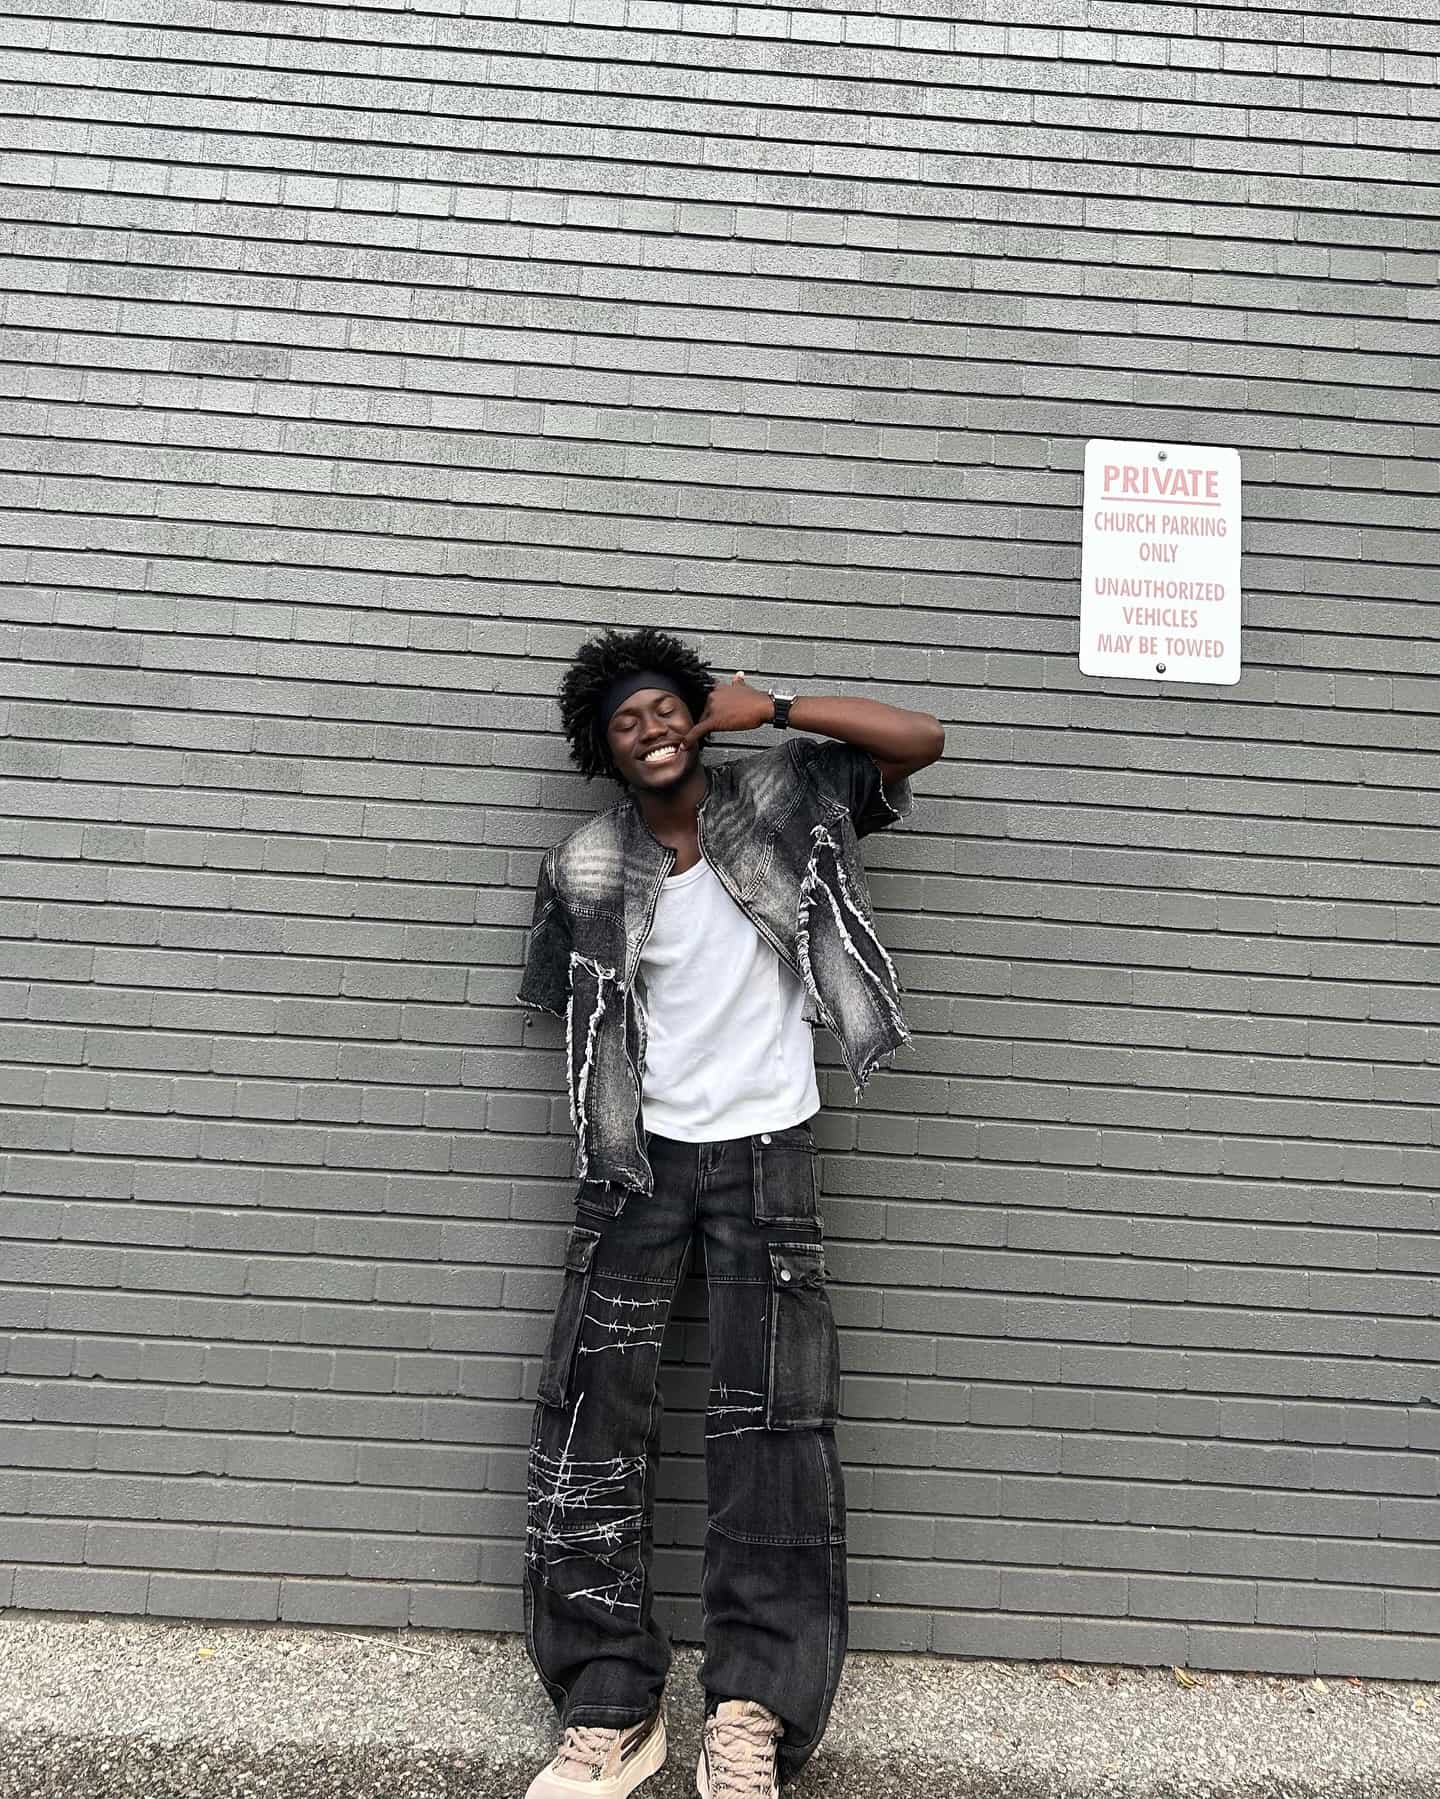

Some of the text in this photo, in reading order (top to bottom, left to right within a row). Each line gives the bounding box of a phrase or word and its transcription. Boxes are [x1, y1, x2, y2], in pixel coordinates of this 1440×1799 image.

[1103, 465, 1218, 498] PRIVATE
[1094, 511, 1227, 537] CHURCH PARKING
[1139, 542, 1178, 563] ONLY
[1095, 577, 1225, 601] UNAUTHORIZED
[1122, 606, 1198, 628] VEHICLES
[1097, 633, 1225, 658] MAY BE TOWED
